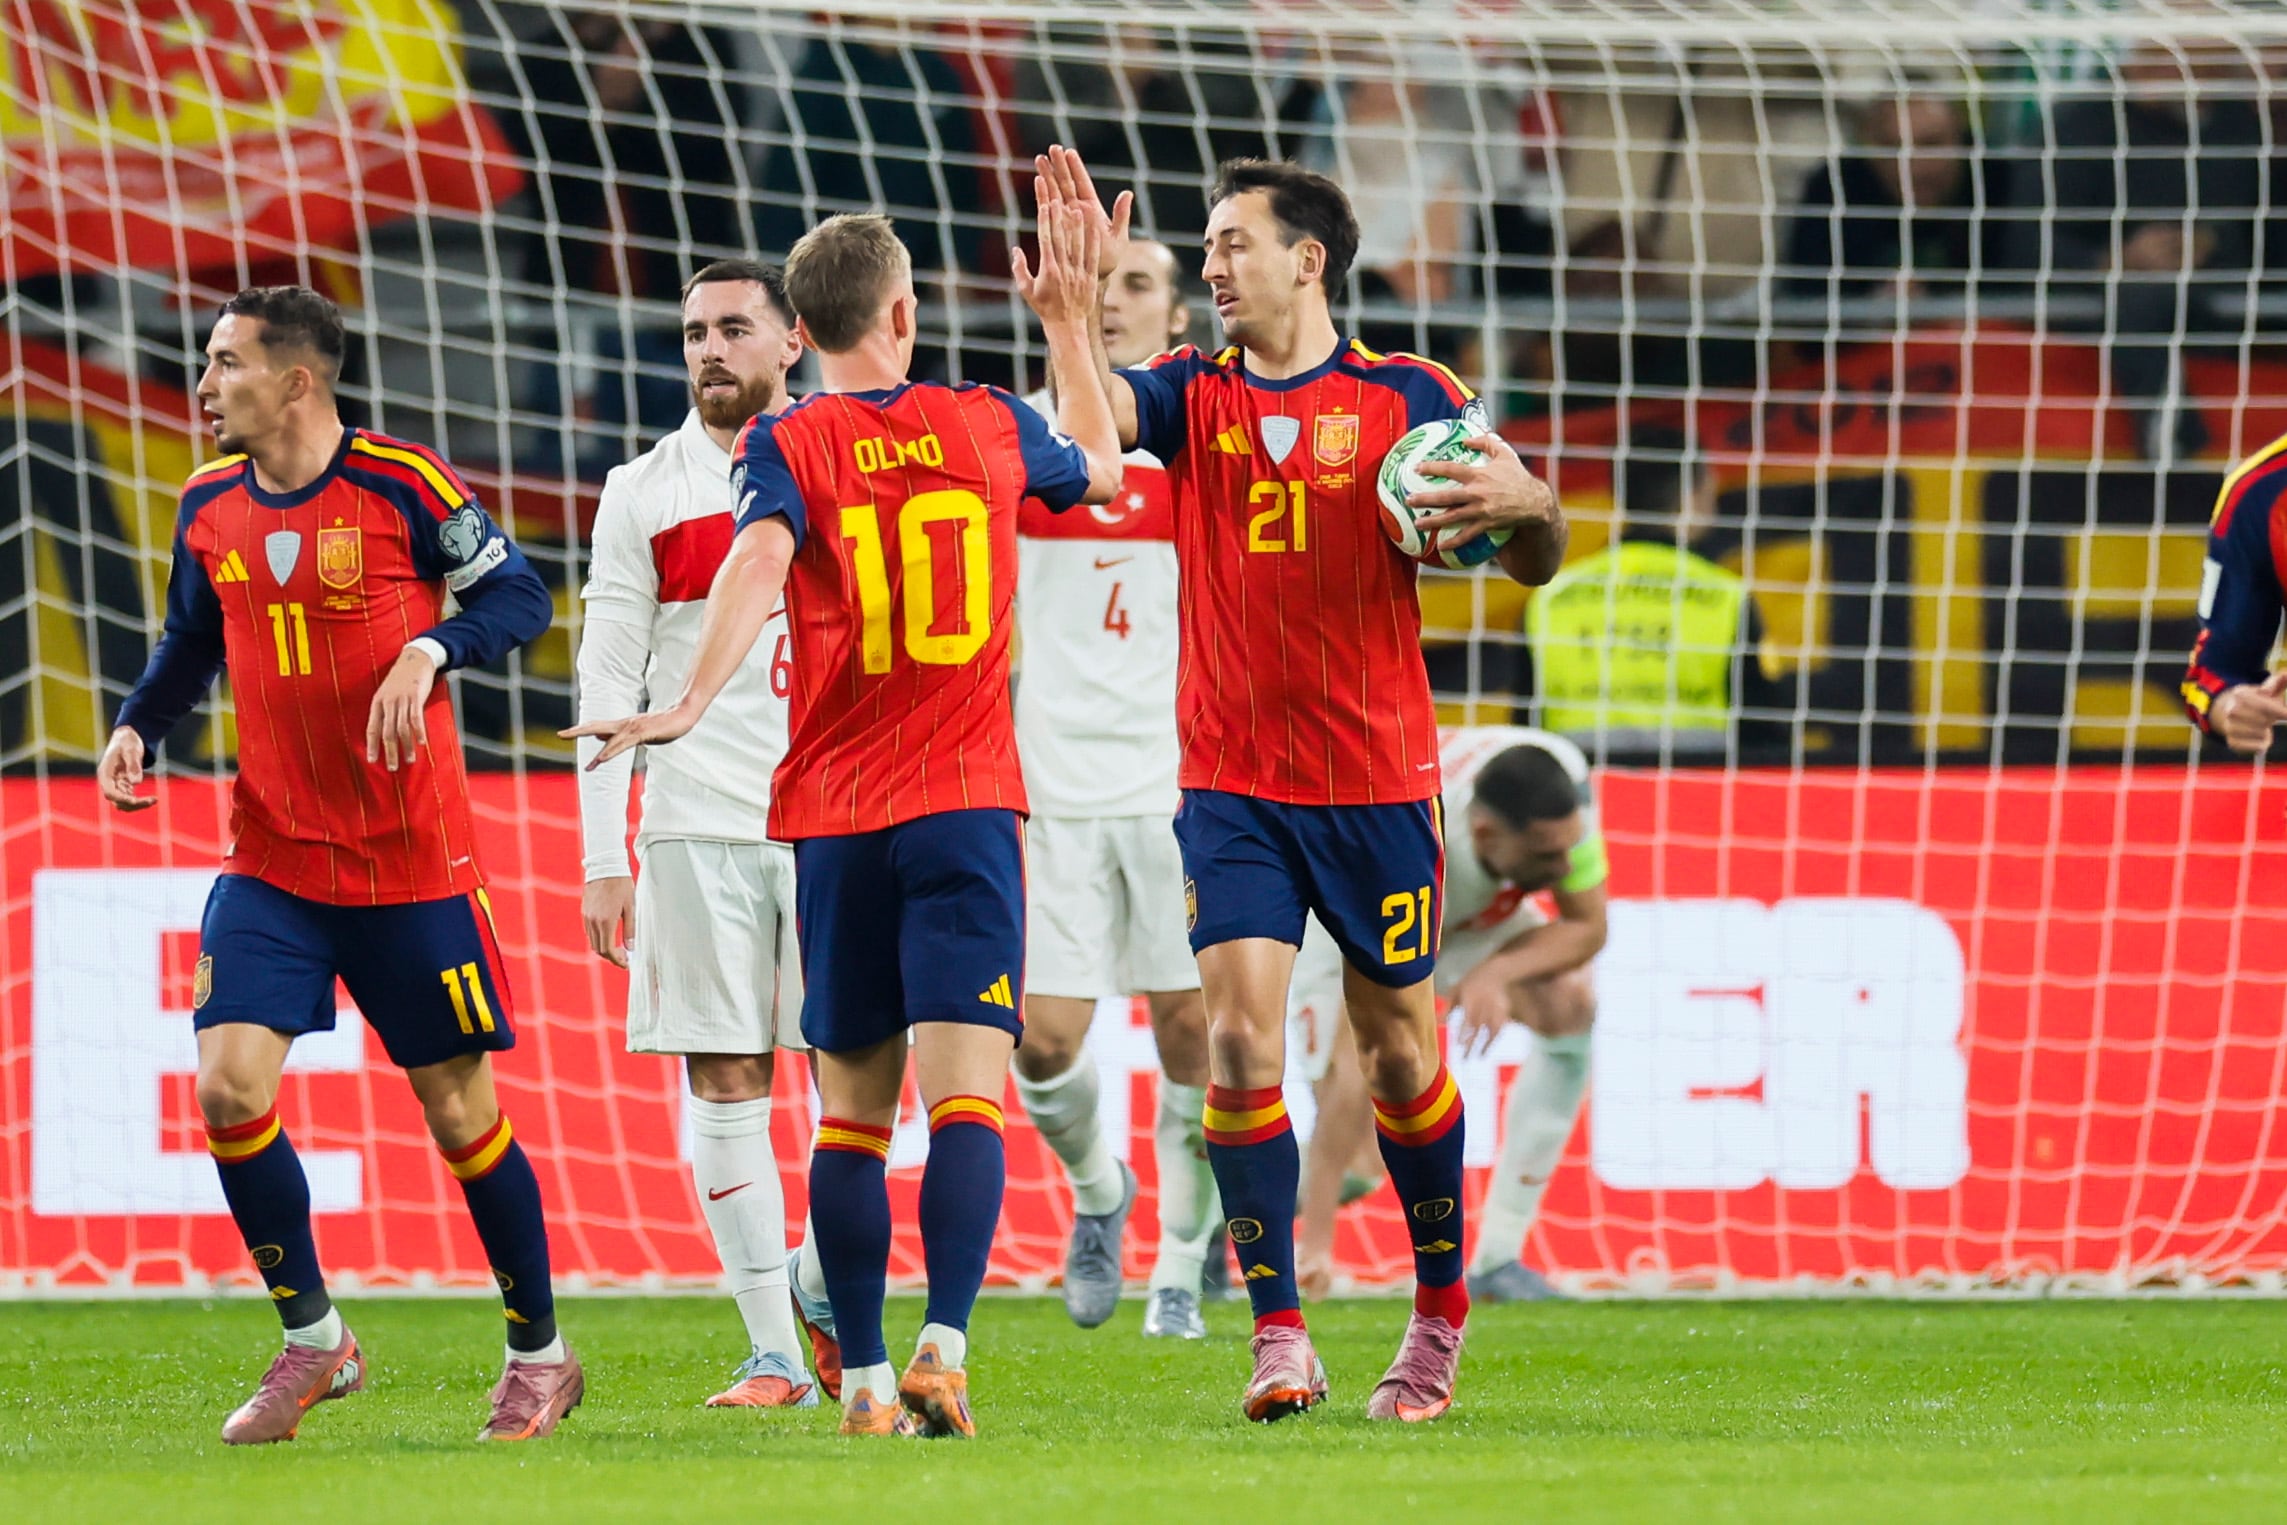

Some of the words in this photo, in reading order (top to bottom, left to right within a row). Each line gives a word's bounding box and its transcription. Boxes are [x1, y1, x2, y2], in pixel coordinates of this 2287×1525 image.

[854, 433, 944, 473] OLMO
[1248, 480, 1306, 553] 21
[840, 488, 992, 675] 10
[1103, 581, 1130, 640] 4
[267, 602, 312, 677] 11
[769, 634, 794, 700] 6
[1381, 885, 1431, 966] 21
[440, 961, 496, 1035] 11
